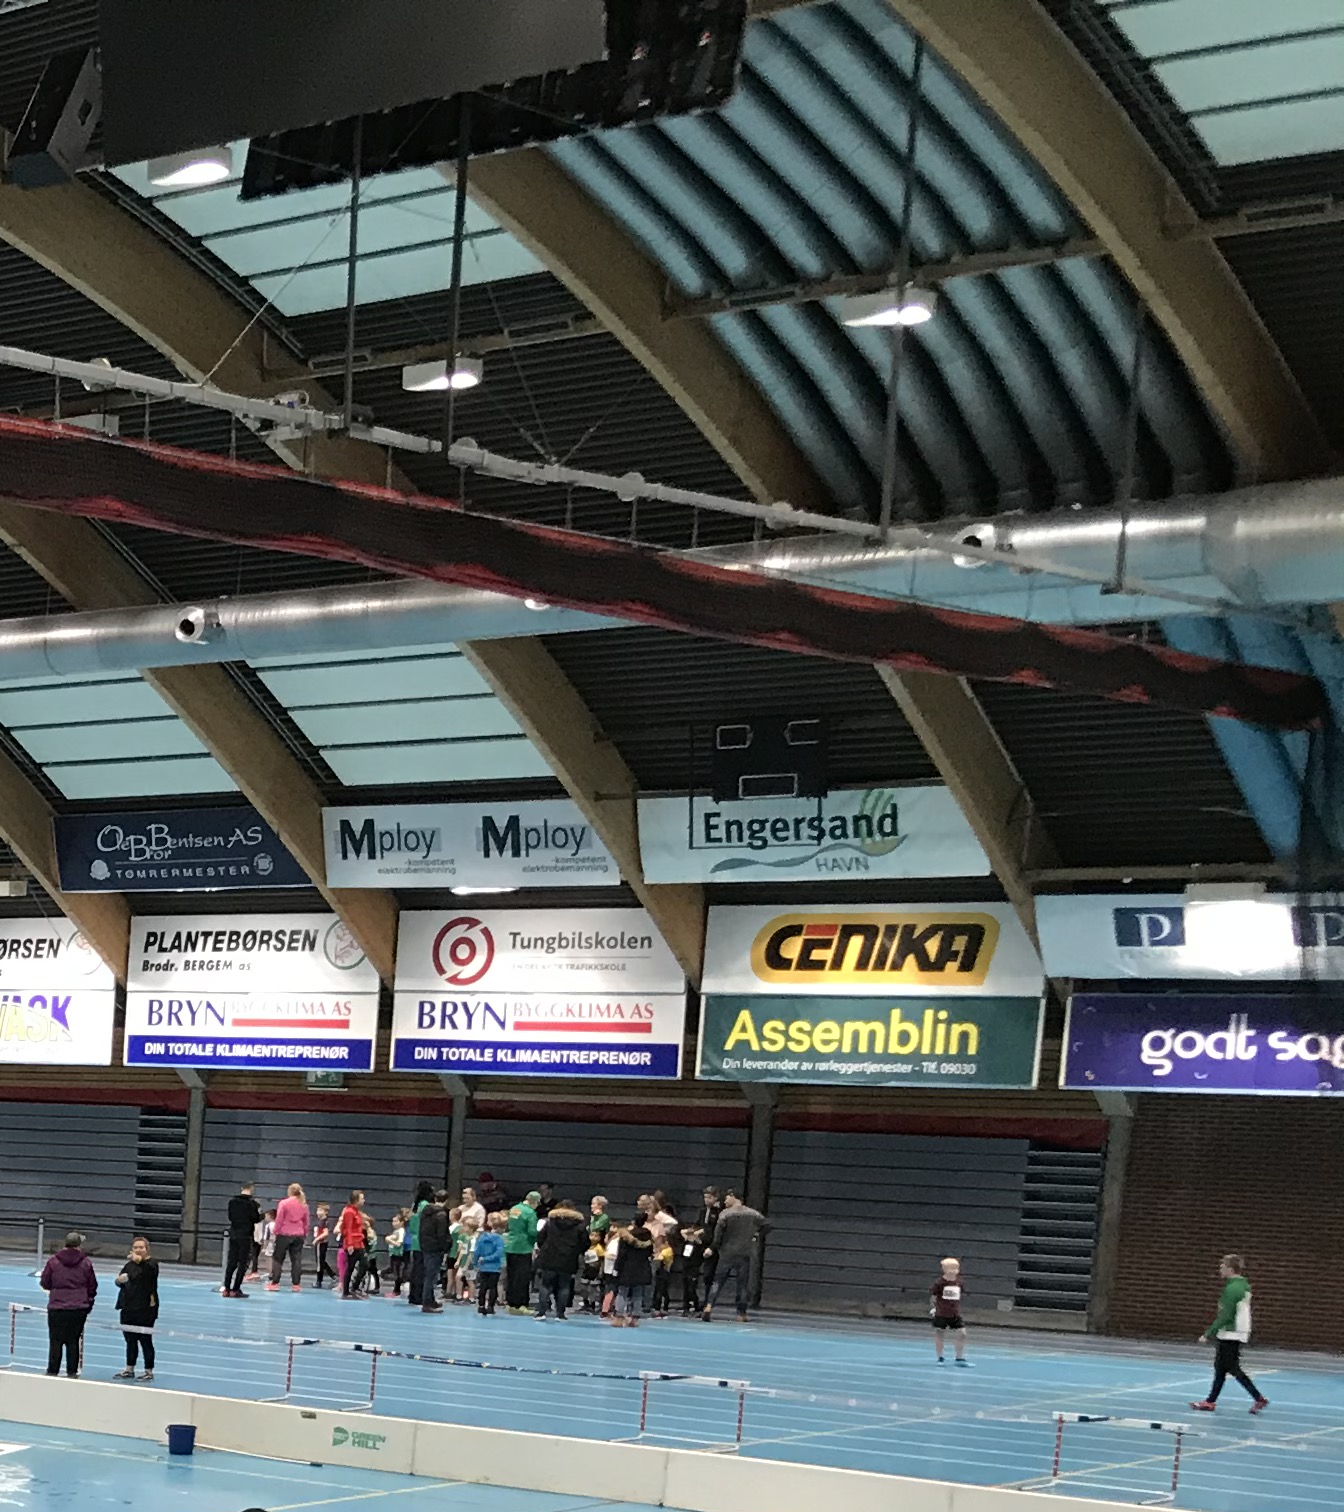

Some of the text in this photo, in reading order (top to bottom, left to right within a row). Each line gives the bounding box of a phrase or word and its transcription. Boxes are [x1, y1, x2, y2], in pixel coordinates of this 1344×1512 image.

[147, 823, 225, 851] Bentsen
[227, 826, 262, 849] AS
[339, 818, 436, 860] Mploy
[482, 814, 587, 858] Mploy
[703, 802, 899, 850] Engersand
[128, 835, 172, 861] Bror
[522, 864, 609, 874] elektrobemanning
[815, 856, 870, 873] HAVN
[144, 929, 319, 954] PLANTEBØRSEN
[509, 931, 653, 954] Tungbilskolen
[764, 923, 986, 973] CENIKA
[183, 960, 232, 972] BERGEM
[239, 962, 251, 971] as
[147, 999, 352, 1027] BRYN BYKLIMA AS
[417, 1000, 654, 1031] BRYN BYGGKLIMA AS
[723, 1008, 980, 1055] Assemblin
[1141, 1013, 1258, 1076] godt
[144, 1042, 349, 1059] DIN TOTALE KLIMAENTREPRENØR
[414, 1046, 651, 1066] DIN TOTALE KLIMAENTREPRENØR
[722, 1057, 739, 1069] Din
[800, 1061, 813, 1071] av
